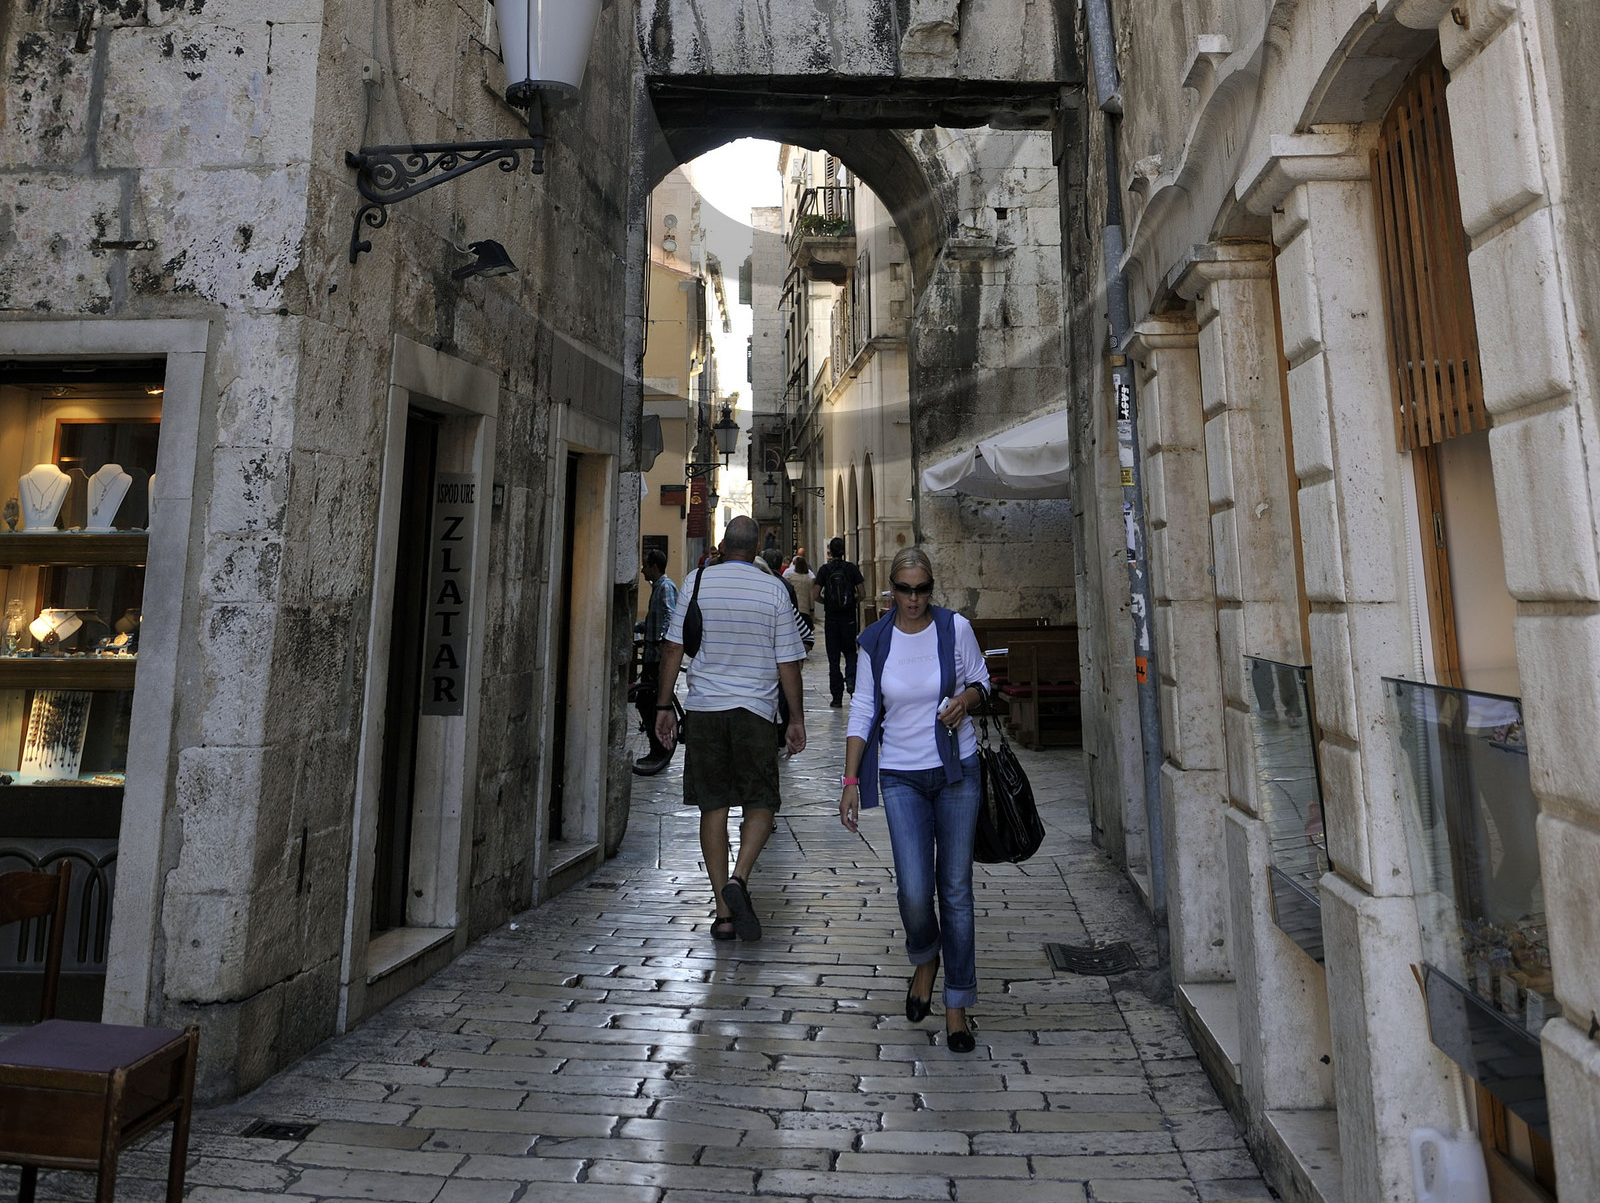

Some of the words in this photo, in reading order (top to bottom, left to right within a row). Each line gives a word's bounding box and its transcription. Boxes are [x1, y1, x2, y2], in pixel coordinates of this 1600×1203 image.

[1120, 386, 1131, 417] EASY
[437, 483, 459, 504] ISPOD
[460, 483, 476, 504] URE
[432, 516, 465, 703] ZLATAR
